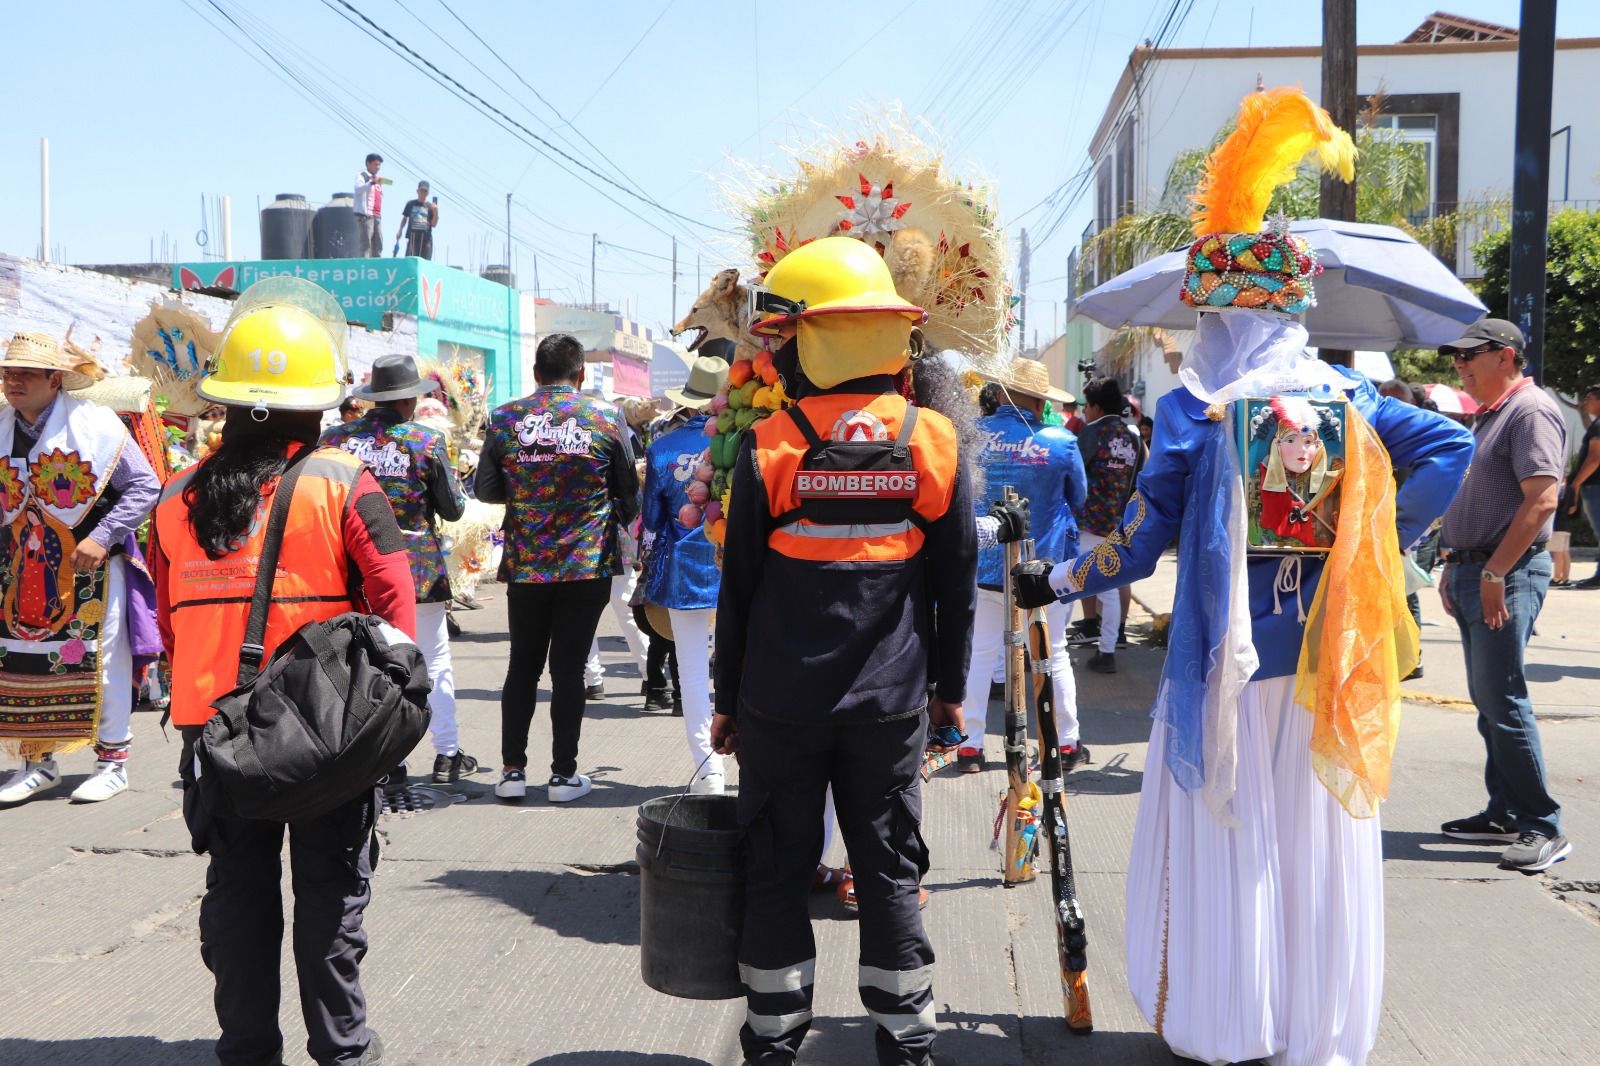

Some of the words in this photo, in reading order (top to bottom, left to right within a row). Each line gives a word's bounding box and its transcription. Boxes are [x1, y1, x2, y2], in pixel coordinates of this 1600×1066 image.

[243, 265, 379, 286] Fisioterapia
[386, 267, 398, 284] y
[247, 348, 288, 375] 19
[797, 475, 917, 492] BOMBEROS
